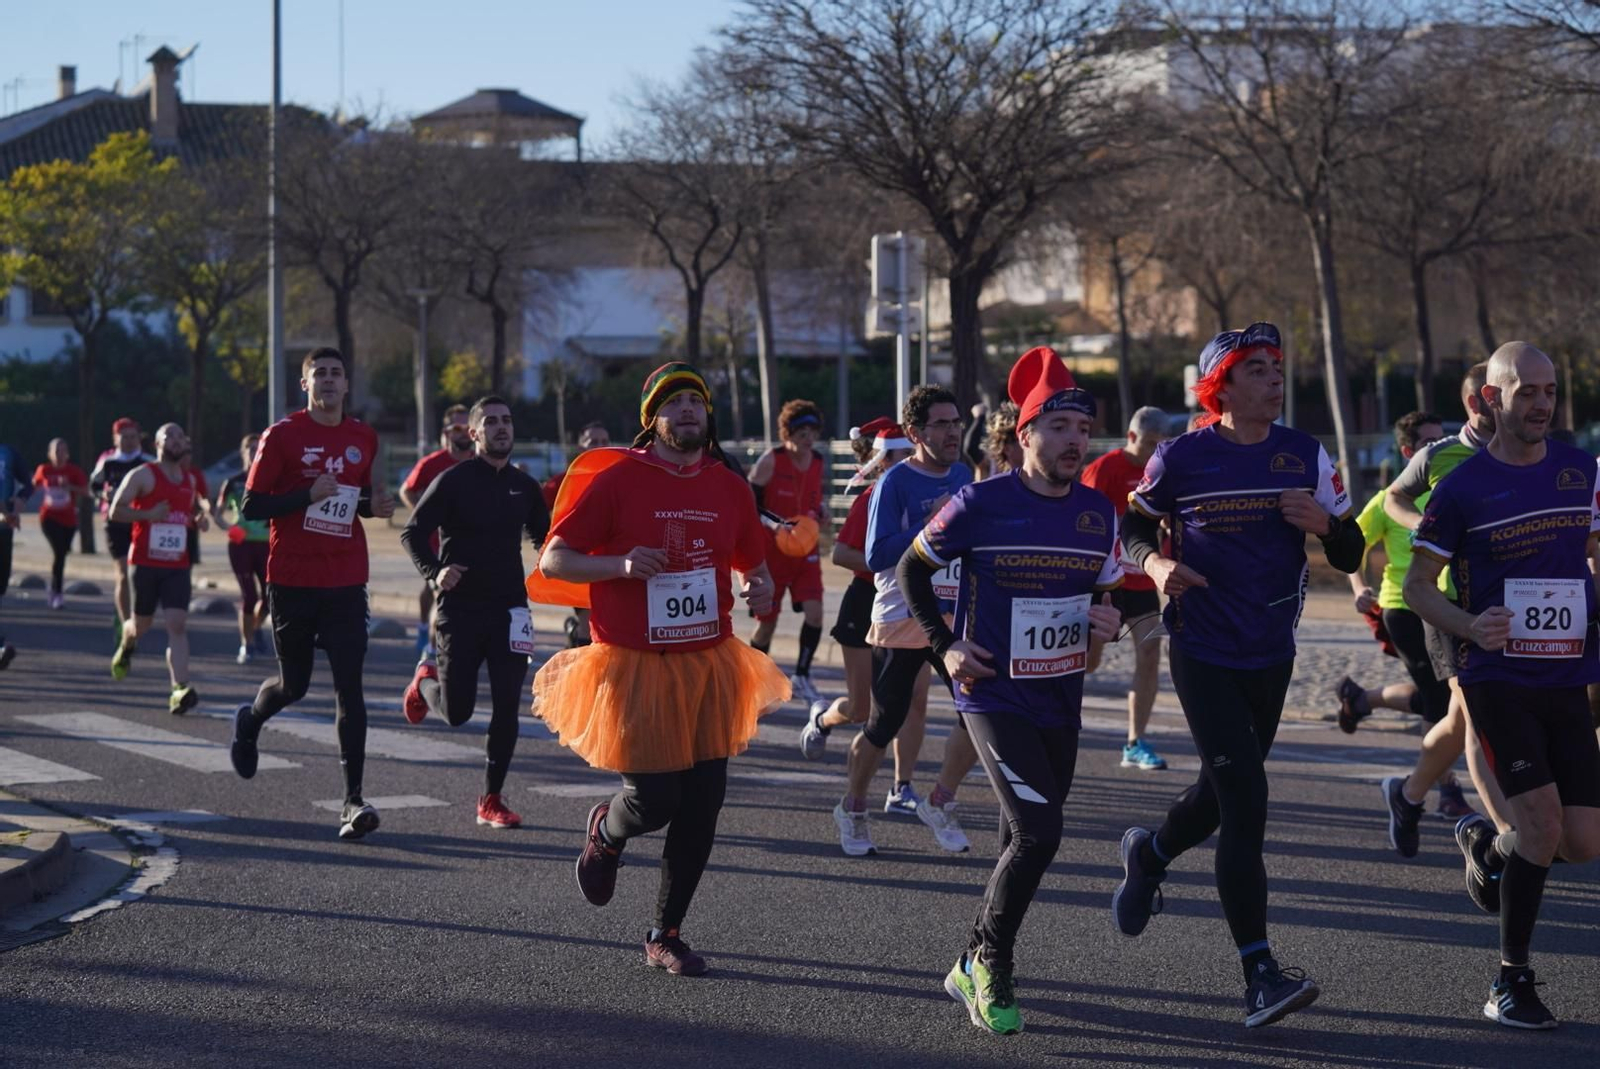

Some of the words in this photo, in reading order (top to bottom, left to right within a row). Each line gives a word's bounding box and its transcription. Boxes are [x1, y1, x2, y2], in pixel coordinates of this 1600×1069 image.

[325, 456, 344, 473] 44
[320, 500, 348, 518] 418
[655, 510, 683, 519] XXXVII
[159, 536, 181, 548] 258
[692, 538, 705, 549] 50
[666, 594, 707, 618] 904
[1525, 606, 1571, 630] 820
[657, 625, 710, 638] Cruzcampo
[1024, 622, 1081, 650] 1028
[1512, 640, 1572, 654] Cruzcampo
[1019, 657, 1075, 673] Cruzcampo
